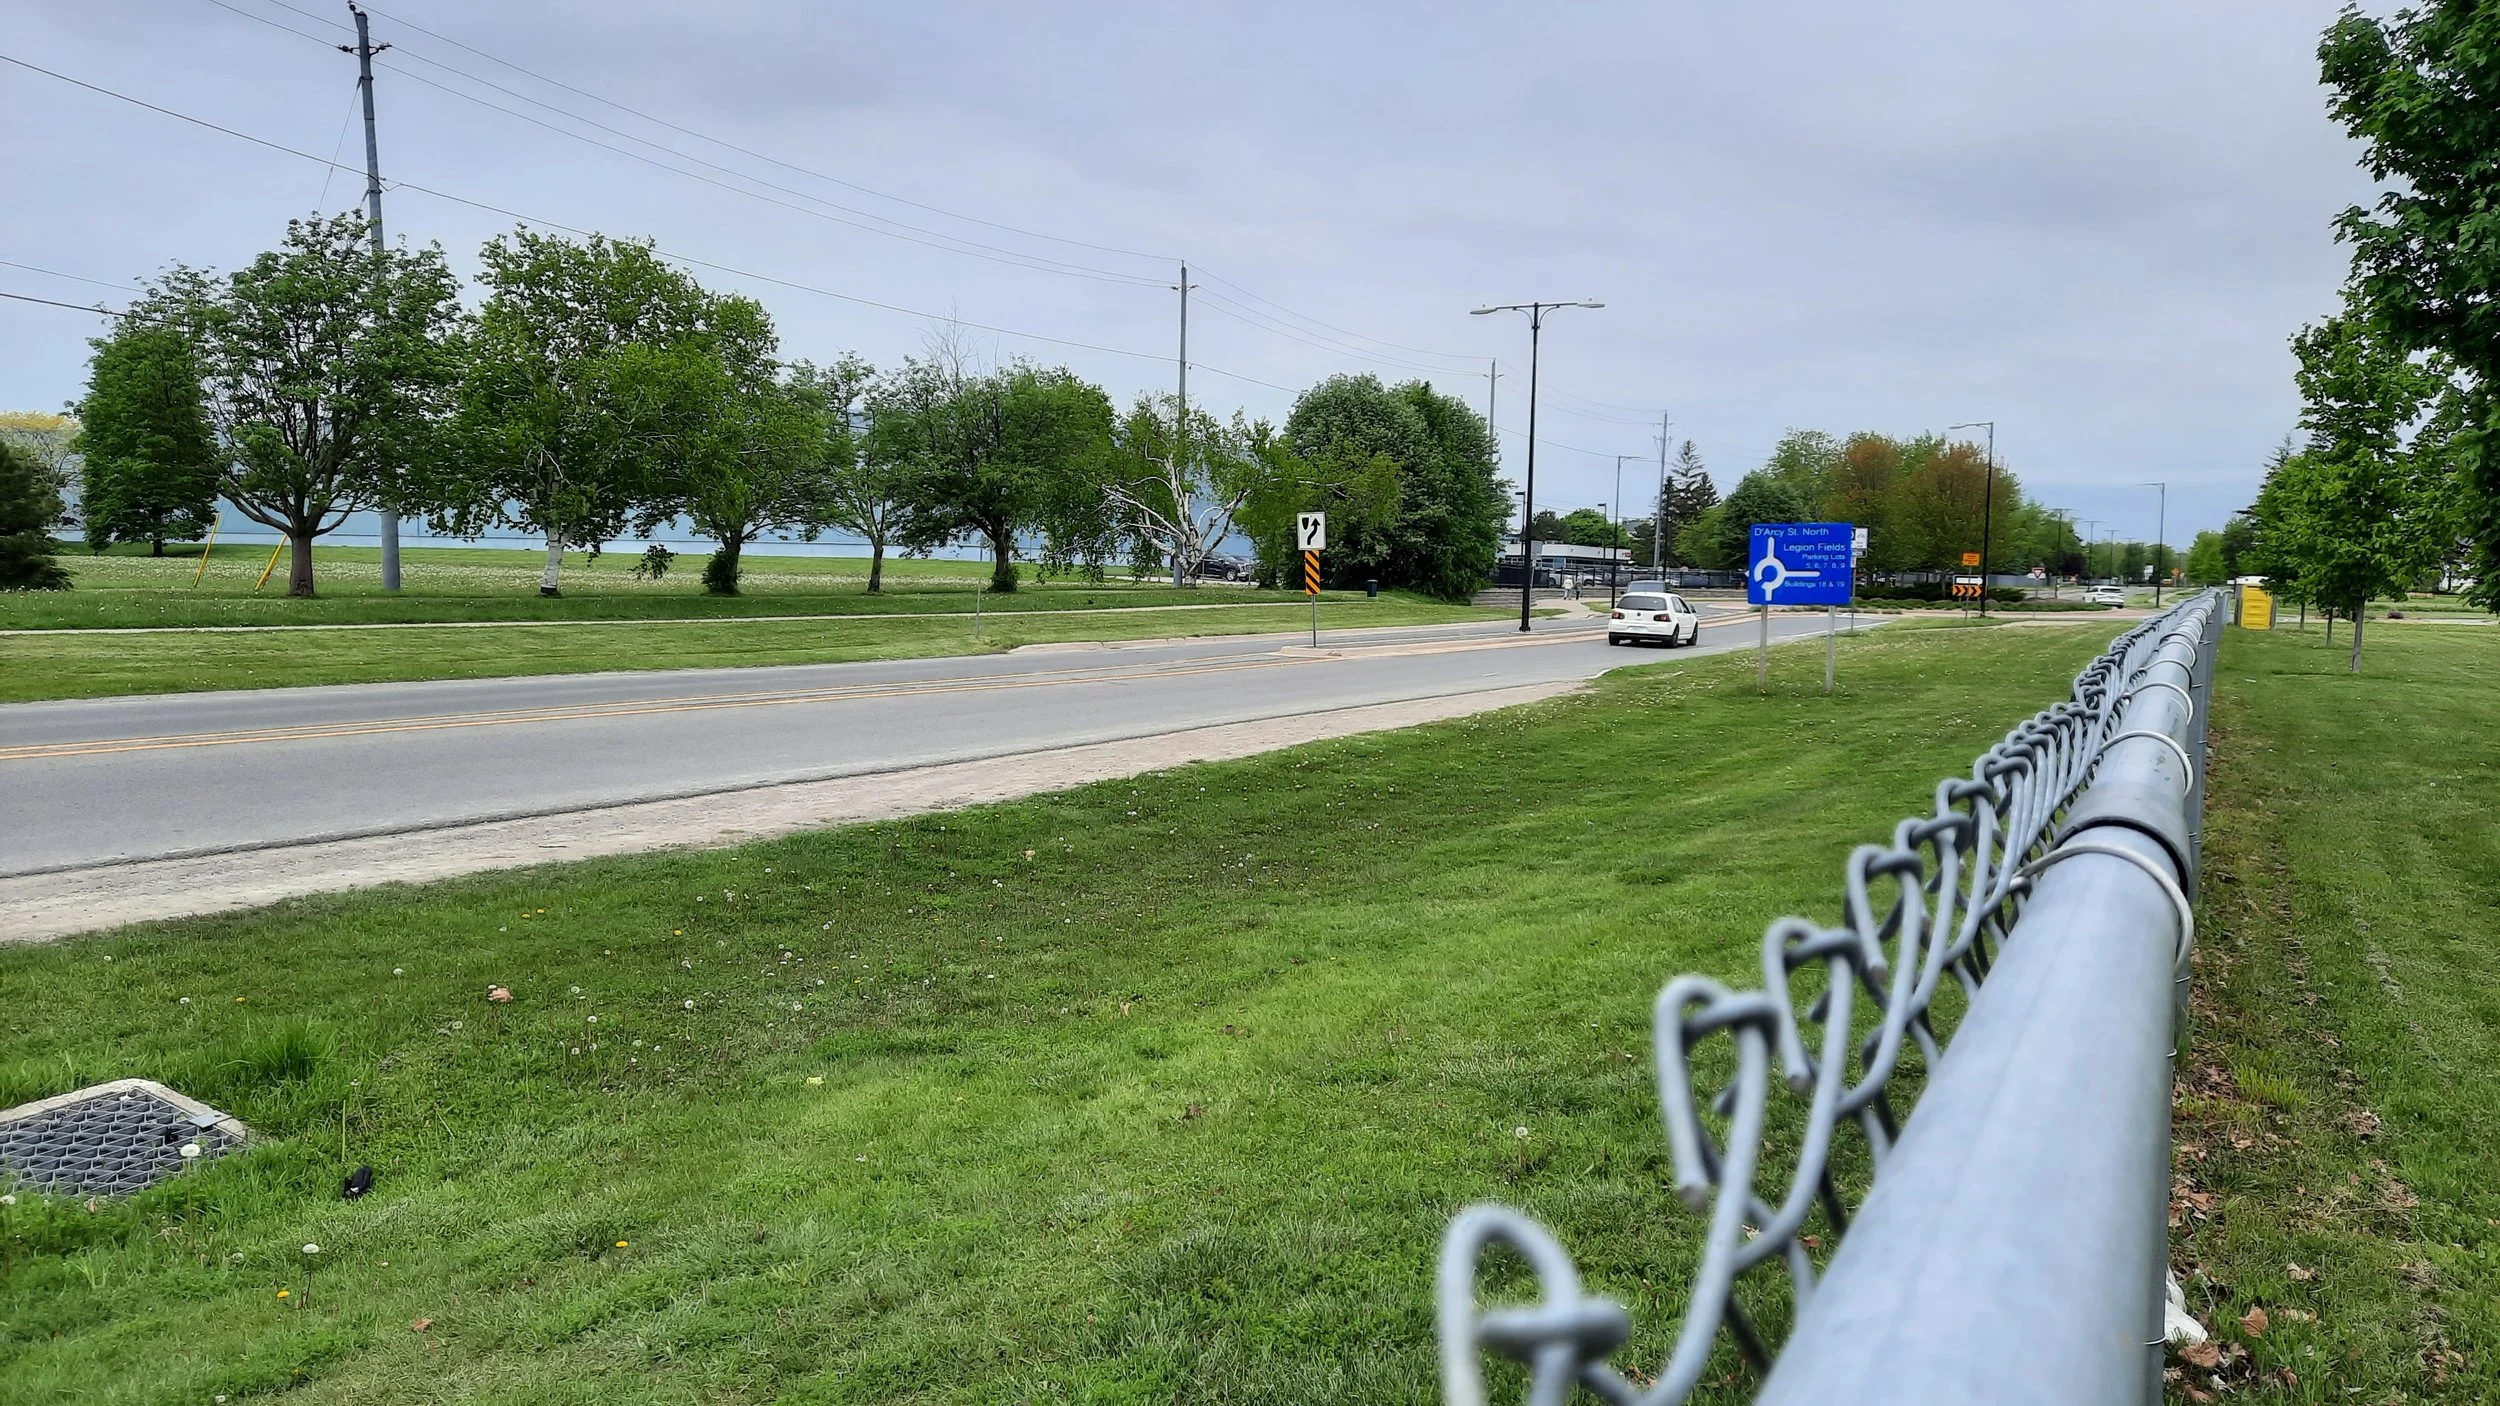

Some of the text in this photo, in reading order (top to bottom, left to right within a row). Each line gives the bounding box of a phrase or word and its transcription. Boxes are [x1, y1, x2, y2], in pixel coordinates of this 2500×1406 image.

[1754, 527, 1829, 537] D'Arcy St. North
[1783, 543, 1815, 553] Legion
[1817, 543, 1846, 551] Fields
